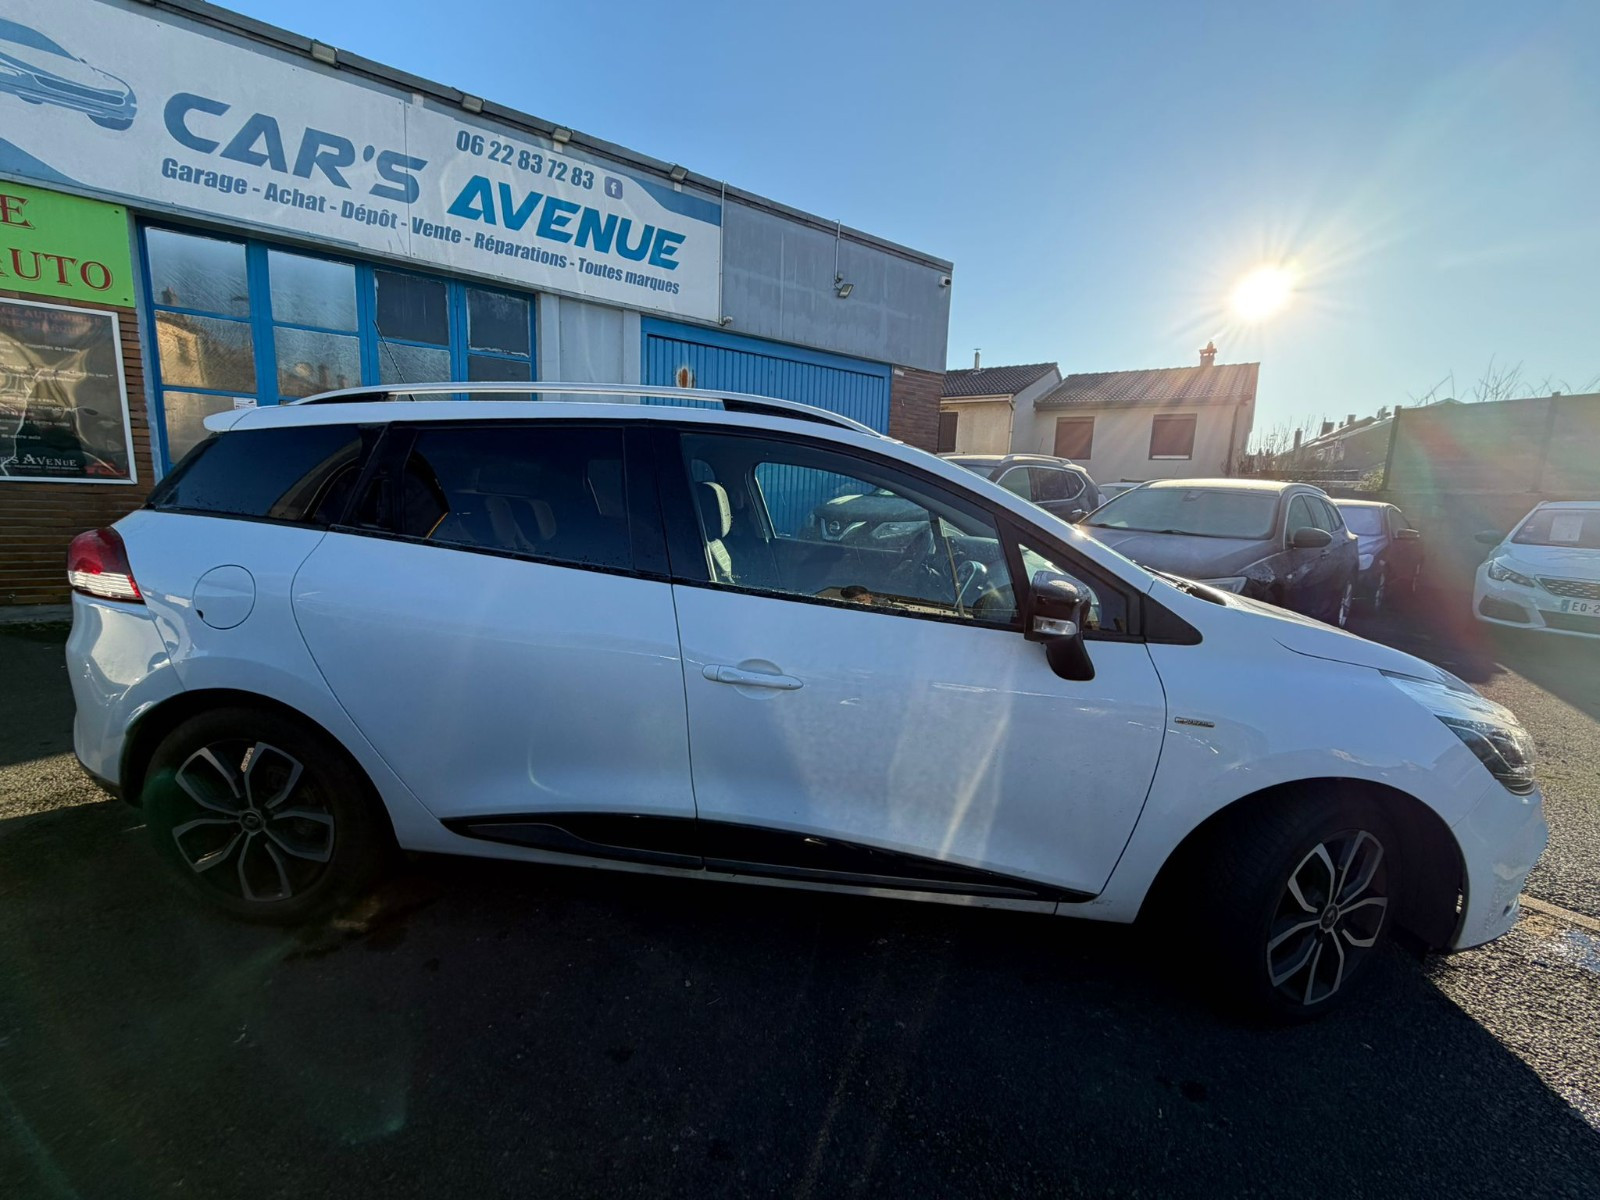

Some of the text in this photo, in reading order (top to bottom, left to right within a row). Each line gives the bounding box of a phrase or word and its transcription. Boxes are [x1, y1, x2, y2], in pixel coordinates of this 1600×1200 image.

[162, 157, 247, 195] Garage
[264, 182, 326, 213] Achat
[340, 201, 398, 231] Dépôt
[412, 217, 461, 244] Vente
[474, 232, 567, 268] Réparations
[577, 256, 623, 281] Toutes
[624, 271, 680, 295] marques
[163, 92, 687, 270] CAR'S AVENUE
[456, 130, 484, 156] 06
[488, 141, 513, 166] 22
[518, 150, 544, 174] 83
[548, 158, 567, 182] 72
[570, 166, 595, 190] 83
